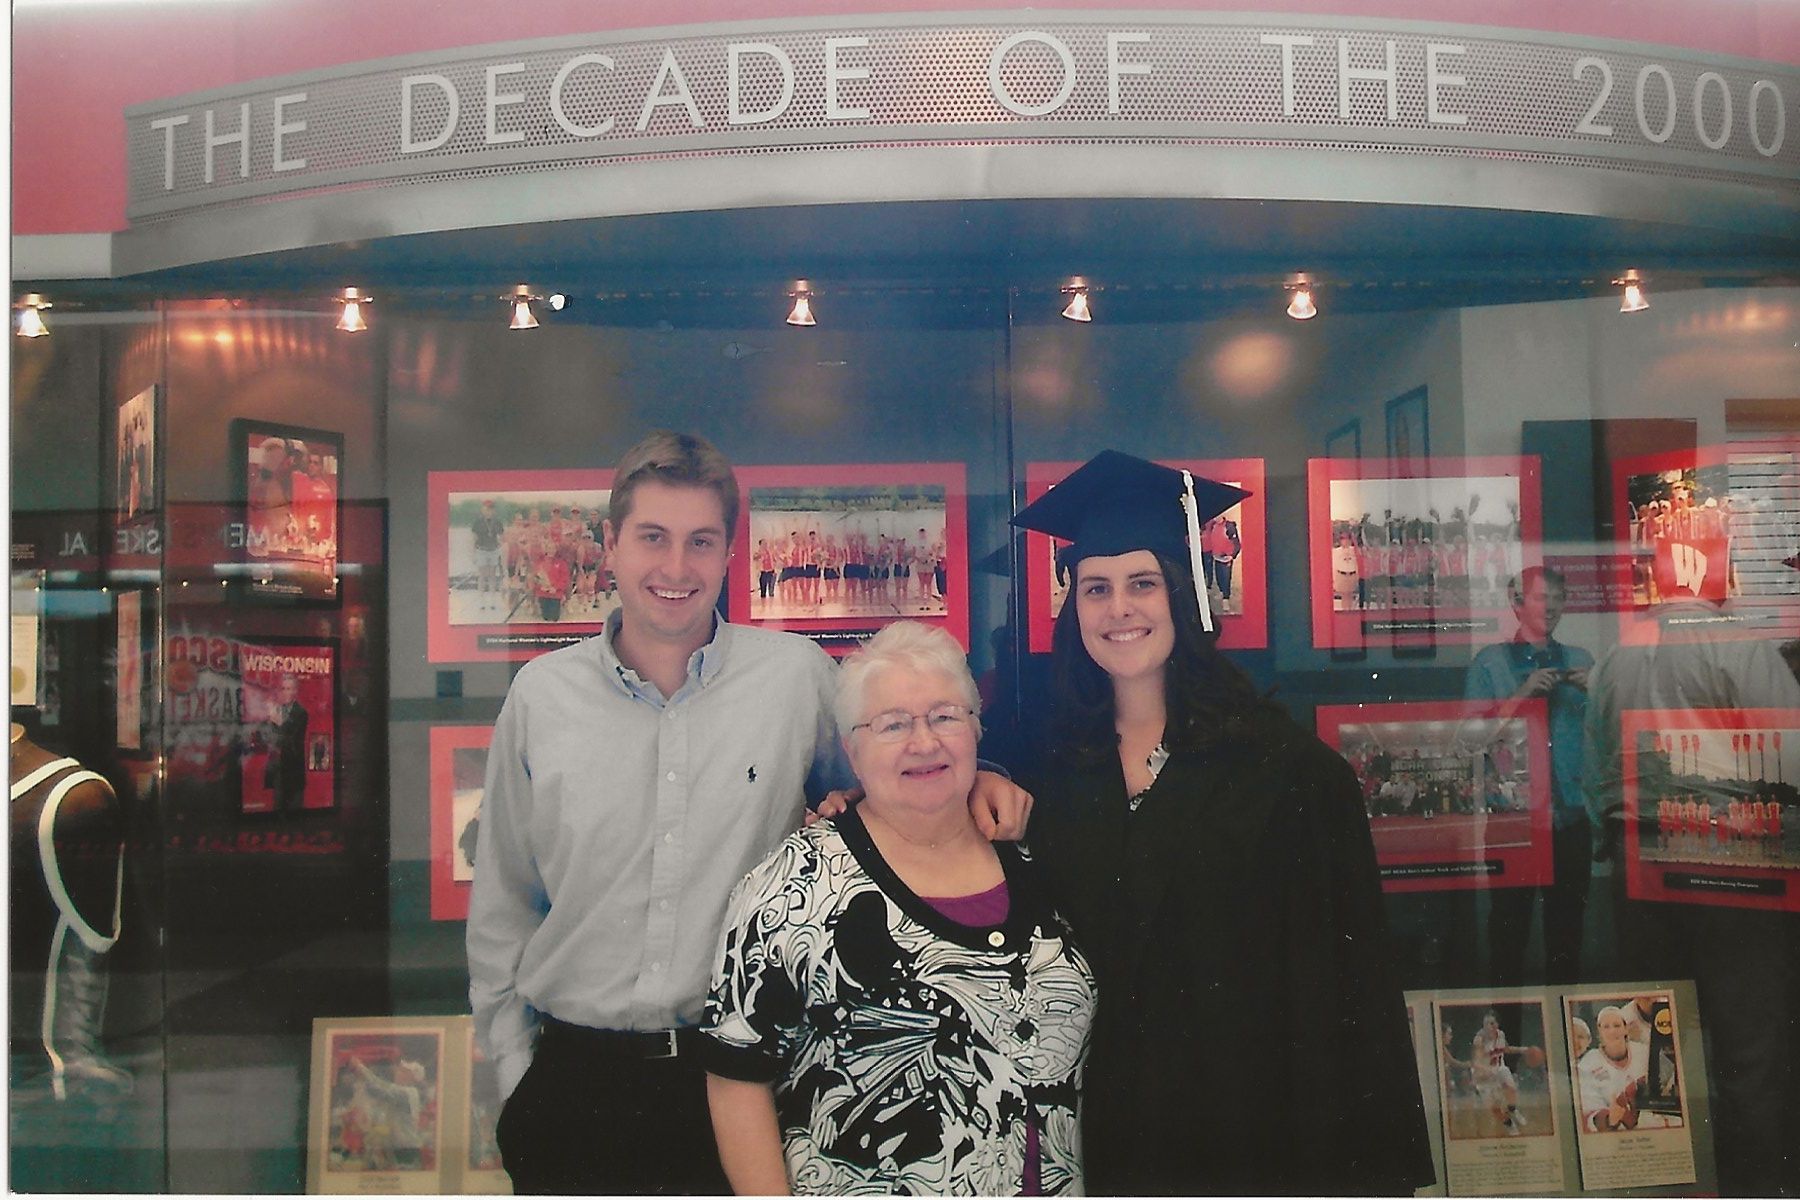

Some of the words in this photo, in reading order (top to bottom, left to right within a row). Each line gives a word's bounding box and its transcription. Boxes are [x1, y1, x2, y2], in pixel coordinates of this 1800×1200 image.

[151, 93, 308, 191] THE
[401, 37, 871, 155] DECADE
[988, 30, 1152, 117] OF
[1260, 35, 1468, 127] THE
[1573, 57, 1787, 157] 2000
[243, 653, 330, 674] WISCONSIN
